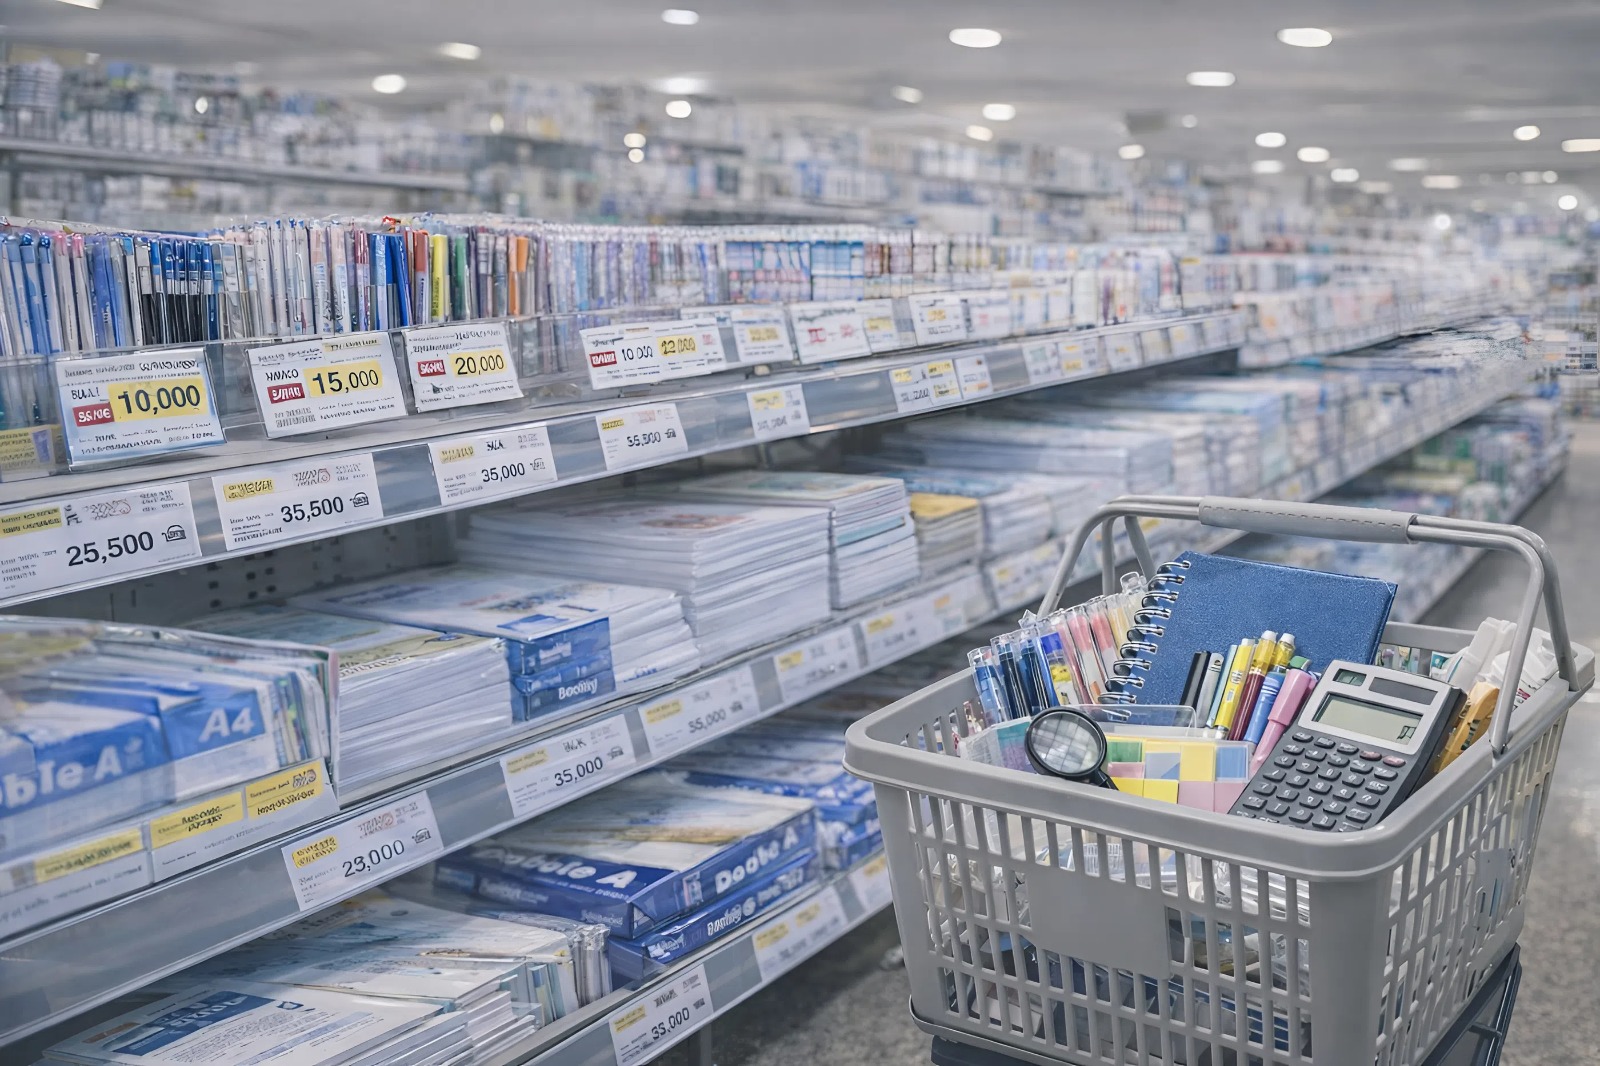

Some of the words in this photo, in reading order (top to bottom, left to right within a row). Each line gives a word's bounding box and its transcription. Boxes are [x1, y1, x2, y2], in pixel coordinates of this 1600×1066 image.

[455, 354, 504, 376] 20,000
[312, 369, 379, 395] 15,000
[117, 385, 201, 415] 10,000
[481, 462, 526, 483] 35,000
[280, 496, 344, 523] 35,500
[65, 531, 154, 567] 25,500
[199, 706, 256, 743] A4
[0, 760, 85, 810] ble
[94, 745, 123, 782] A
[554, 756, 604, 787] 35,000
[783, 825, 799, 850] A
[595, 870, 638, 889] A
